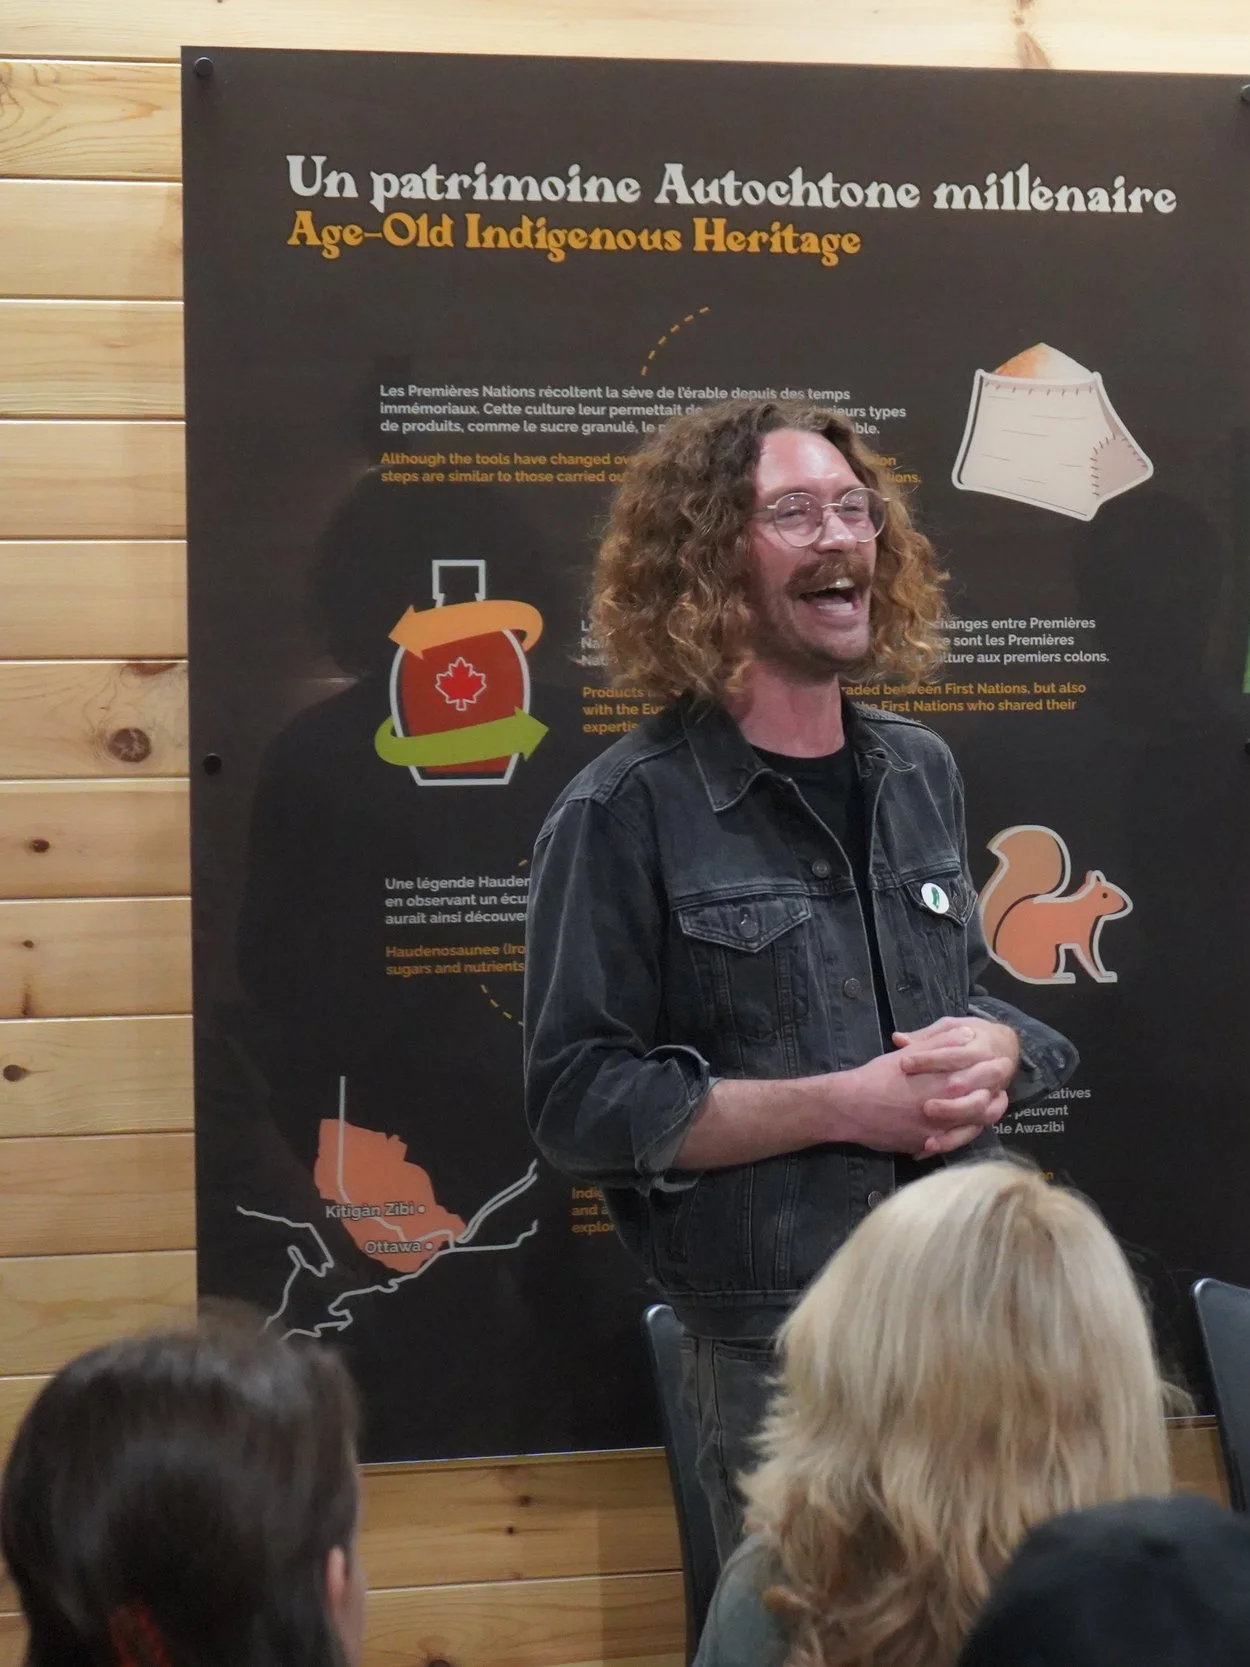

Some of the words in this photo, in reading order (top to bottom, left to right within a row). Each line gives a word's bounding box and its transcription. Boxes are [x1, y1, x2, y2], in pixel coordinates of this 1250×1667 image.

[286, 154, 359, 198] Un
[369, 161, 641, 213] patrimoine
[654, 162, 920, 208] Autochtone
[933, 162, 1177, 214] millénaire
[286, 210, 455, 259] Age-Old
[464, 213, 682, 263] Indigenous
[692, 217, 861, 267] Heritage
[380, 385, 405, 397] Les
[408, 385, 479, 398] Premières
[482, 385, 536, 398] Nations
[539, 385, 602, 399] récoltent
[605, 386, 619, 398] la
[622, 386, 654, 399] sève
[657, 387, 675, 399] de
[731, 388, 776, 401] depuis
[780, 388, 804, 400] des
[808, 388, 850, 402] temps
[380, 402, 480, 415] immémoriaux.
[483, 403, 522, 415] Cette
[524, 403, 576, 415] culture
[578, 404, 605, 415] leur
[609, 404, 682, 418] permettait
[869, 405, 906, 420] types
[380, 421, 399, 432] de
[402, 420, 464, 434] produits,
[467, 422, 520, 432] comme
[523, 421, 536, 432] le
[540, 423, 578, 433] sucre
[582, 421, 639, 435] granulé,
[642, 421, 655, 433] le
[380, 452, 446, 467] Although
[449, 453, 471, 465] the
[476, 453, 510, 465] tools
[513, 453, 546, 465] have
[550, 454, 611, 468] changed
[381, 471, 419, 485] steps
[422, 472, 444, 482] are
[448, 471, 493, 482] similar
[497, 472, 511, 482] to
[514, 471, 553, 482] those
[556, 471, 605, 482] carried
[991, 619, 1027, 630] entre
[1029, 617, 1096, 629] Premières
[953, 635, 983, 646] sont
[985, 635, 1005, 646] les
[1008, 634, 1075, 646] Premières
[976, 654, 1000, 663] aux
[1003, 651, 1061, 665] premiers
[1064, 651, 1110, 662] colons.
[583, 686, 645, 698] Products
[842, 684, 880, 695] raded
[945, 683, 973, 695] First
[977, 683, 1031, 697] Nations,
[1034, 682, 1055, 694] but
[1058, 682, 1086, 693] also
[583, 704, 612, 716] with
[616, 704, 639, 715] the
[881, 700, 909, 711] First
[913, 700, 964, 712] Nations
[968, 700, 995, 711] who
[998, 700, 1043, 711] shared
[1046, 699, 1076, 710] their
[385, 878, 414, 890] Une
[416, 877, 475, 892] légende
[385, 898, 403, 907] en
[406, 894, 476, 907] observant
[479, 895, 497, 905] un
[385, 912, 427, 925] aurait
[429, 911, 462, 923] ainsi
[465, 910, 528, 923] découve
[385, 945, 499, 958] Haudenosaunee
[386, 965, 432, 978] sugars
[435, 962, 461, 974] and
[464, 961, 525, 973] nutrients
[1014, 1104, 1069, 1119] peuvent
[1014, 1121, 1064, 1133] Awazibi
[364, 1241, 421, 1254] Ottawa
